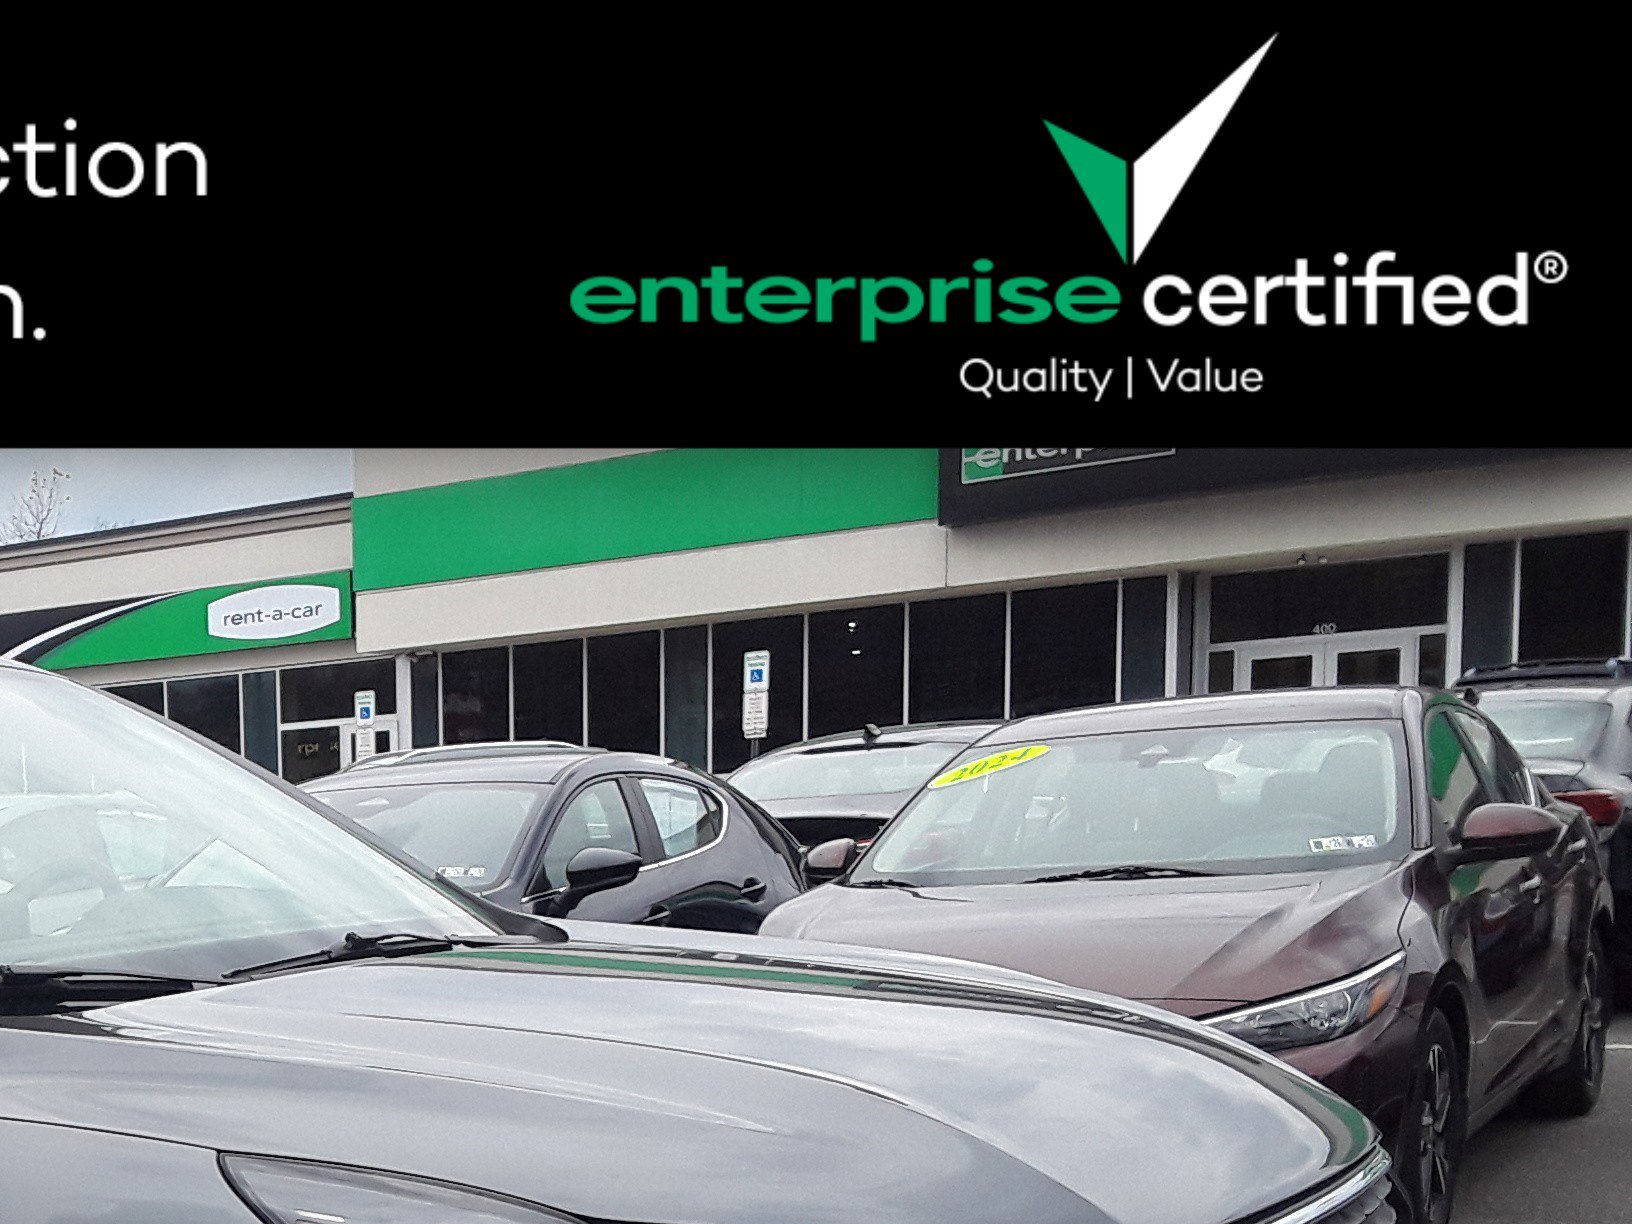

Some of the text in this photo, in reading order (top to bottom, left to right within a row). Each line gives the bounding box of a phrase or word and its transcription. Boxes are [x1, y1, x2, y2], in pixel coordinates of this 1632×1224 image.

[223, 603, 323, 627] rent-a-car
[1311, 623, 1337, 636] 400
[950, 748, 1032, 782] 2024
